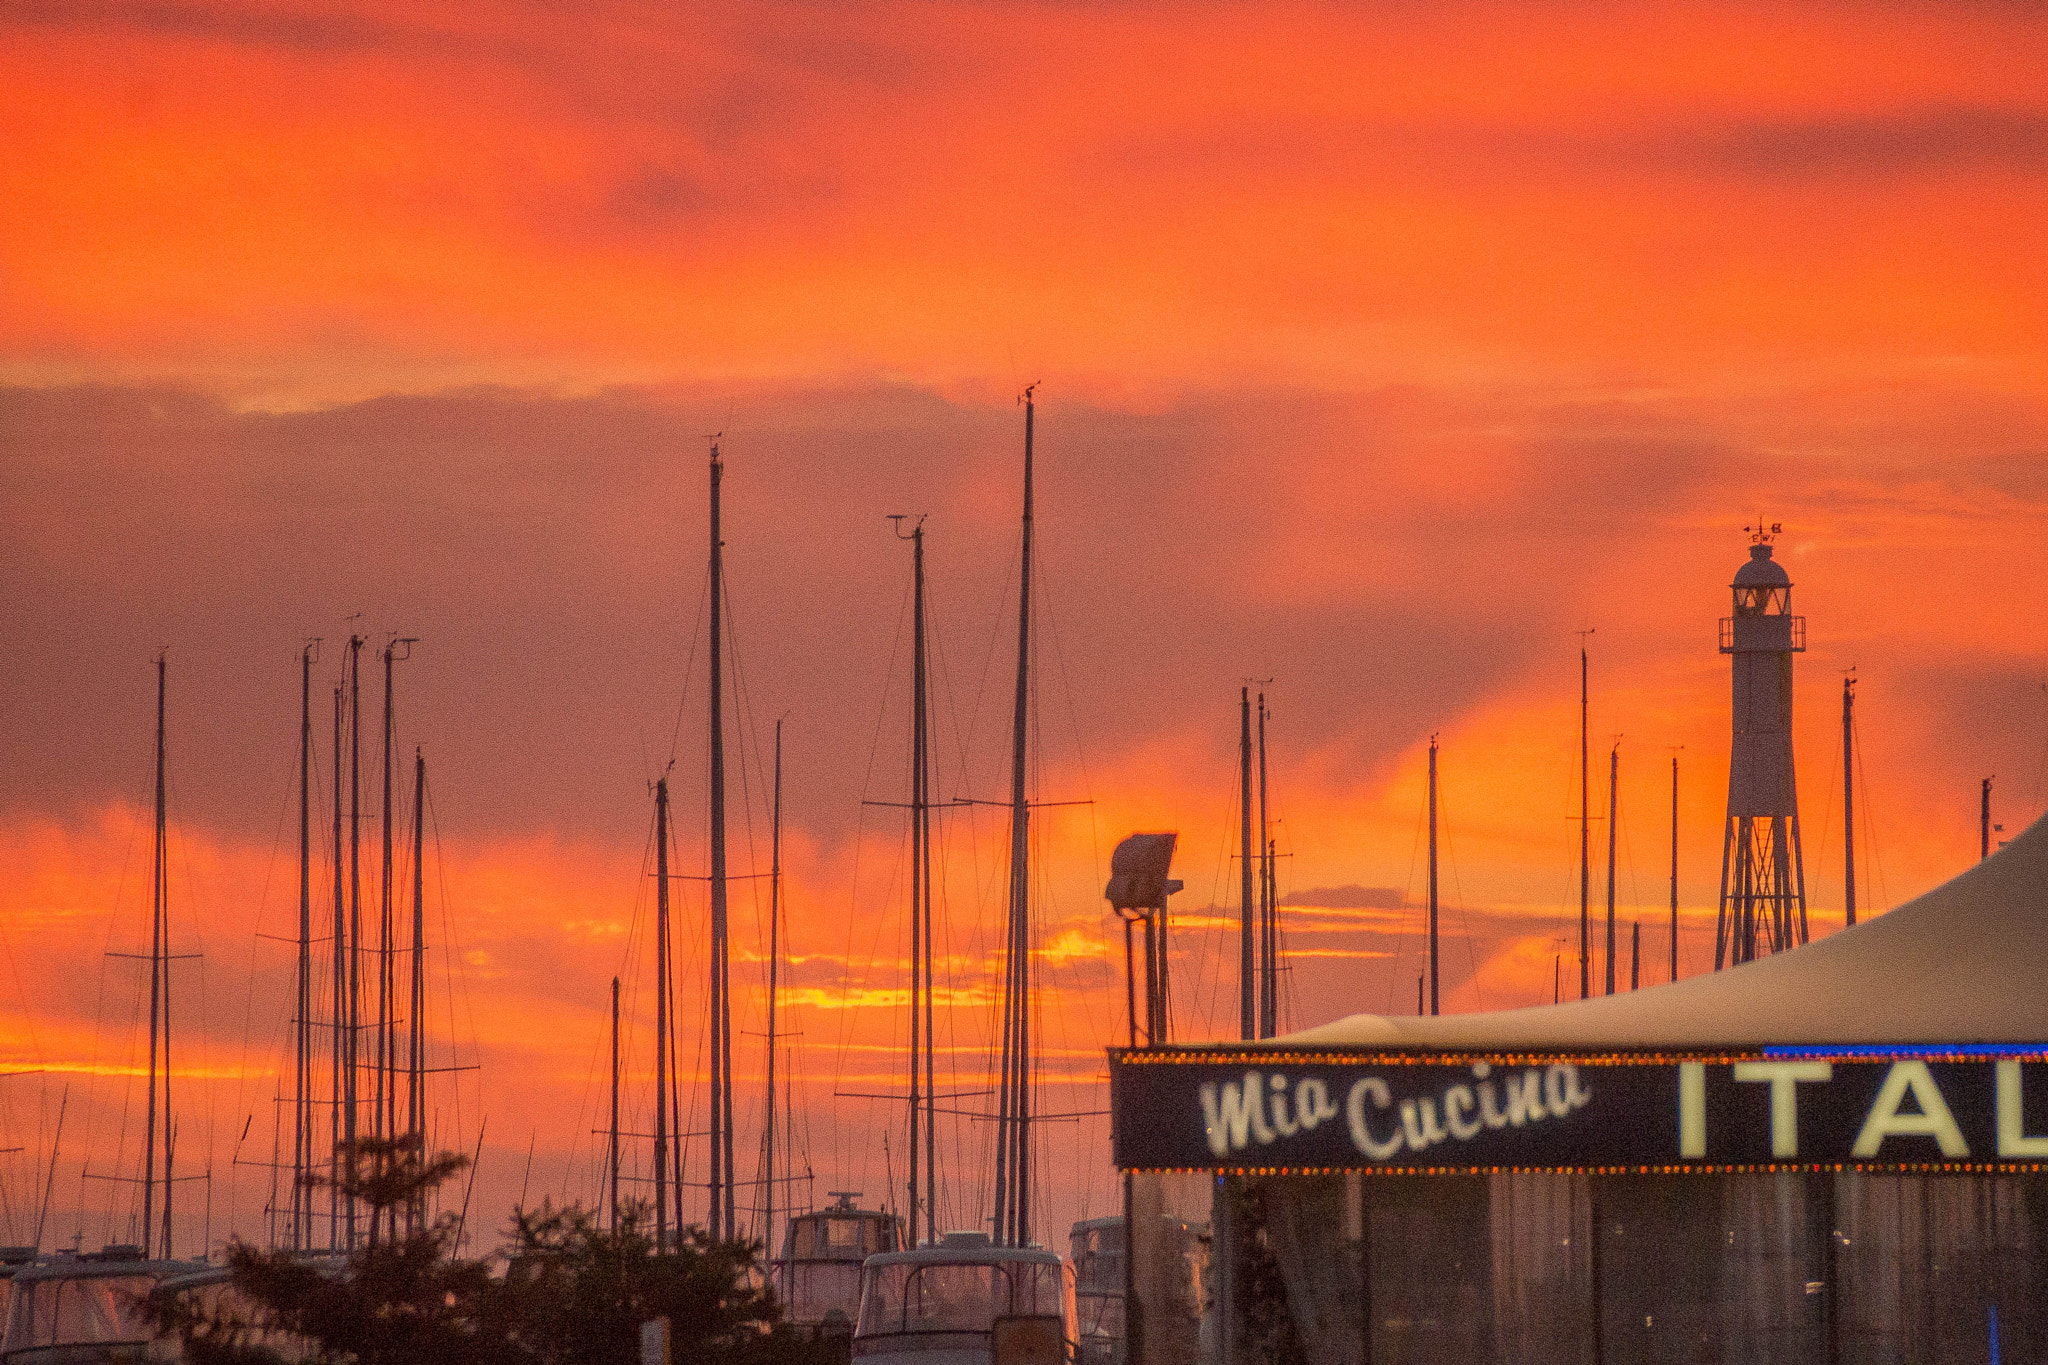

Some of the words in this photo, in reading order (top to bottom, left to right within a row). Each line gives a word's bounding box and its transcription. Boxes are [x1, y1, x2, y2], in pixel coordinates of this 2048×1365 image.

[1752, 534, 1759, 542] E
[1200, 1070, 1338, 1156] Mia
[1346, 1060, 1592, 1161] Cucina
[1678, 1060, 2048, 1158] ITAL
